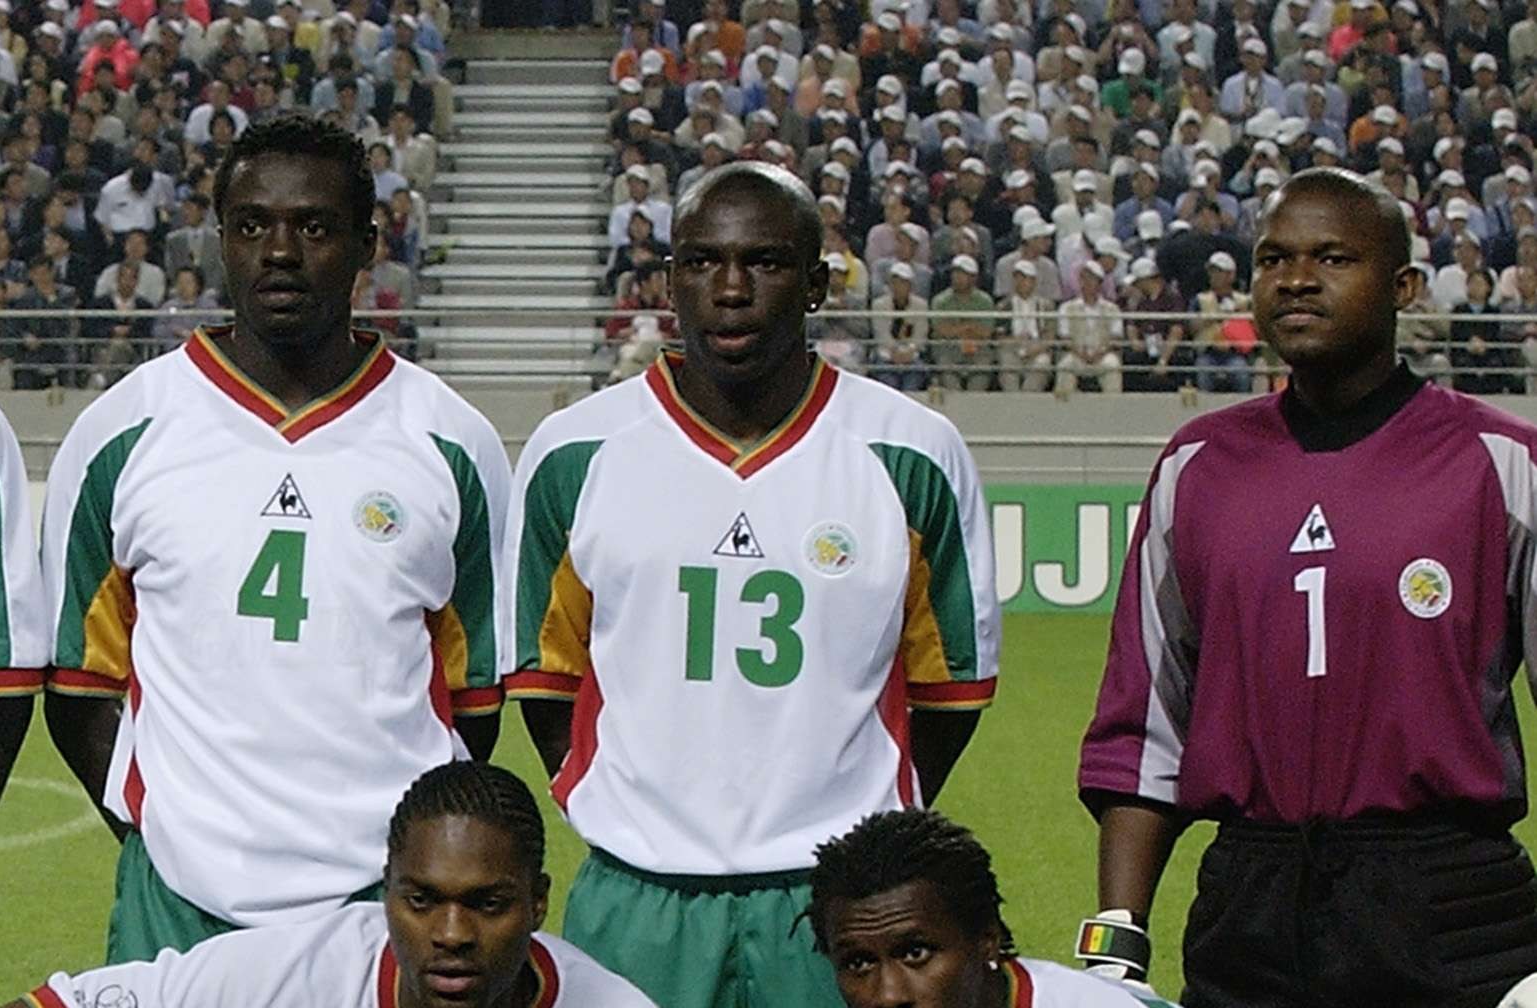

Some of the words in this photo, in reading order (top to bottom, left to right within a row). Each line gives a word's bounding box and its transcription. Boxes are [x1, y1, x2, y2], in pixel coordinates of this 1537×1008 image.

[238, 530, 308, 641] 4
[679, 566, 804, 686] 13
[1294, 567, 1326, 677] 1
